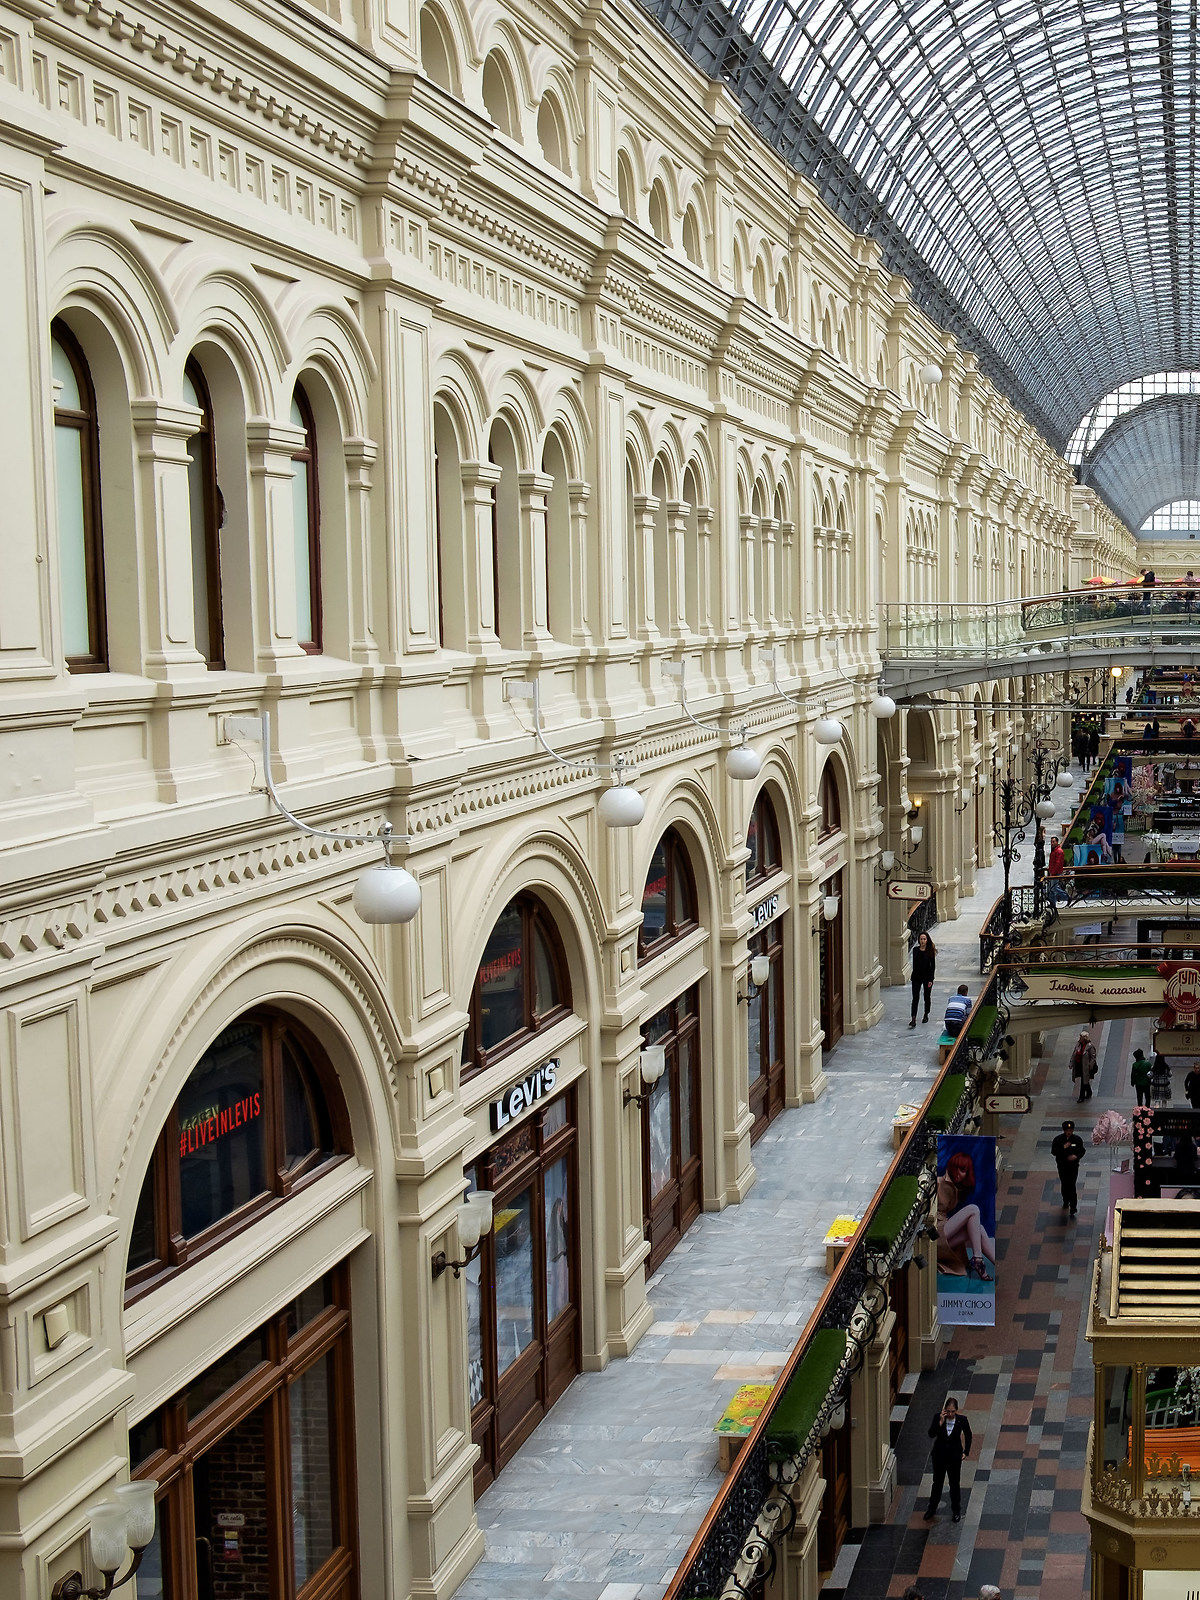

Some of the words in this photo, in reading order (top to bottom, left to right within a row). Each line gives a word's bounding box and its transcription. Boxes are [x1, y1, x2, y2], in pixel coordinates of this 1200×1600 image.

[1049, 979, 1096, 995] Главный
[1100, 986, 1147, 996] магазин
[1185, 1036, 1191, 1044] 2
[490, 1060, 560, 1135] Levi's
[180, 1092, 261, 1158] #LIVEINLEVIS
[941, 1299, 963, 1308] JIMMY
[965, 1300, 992, 1309] CHOO
